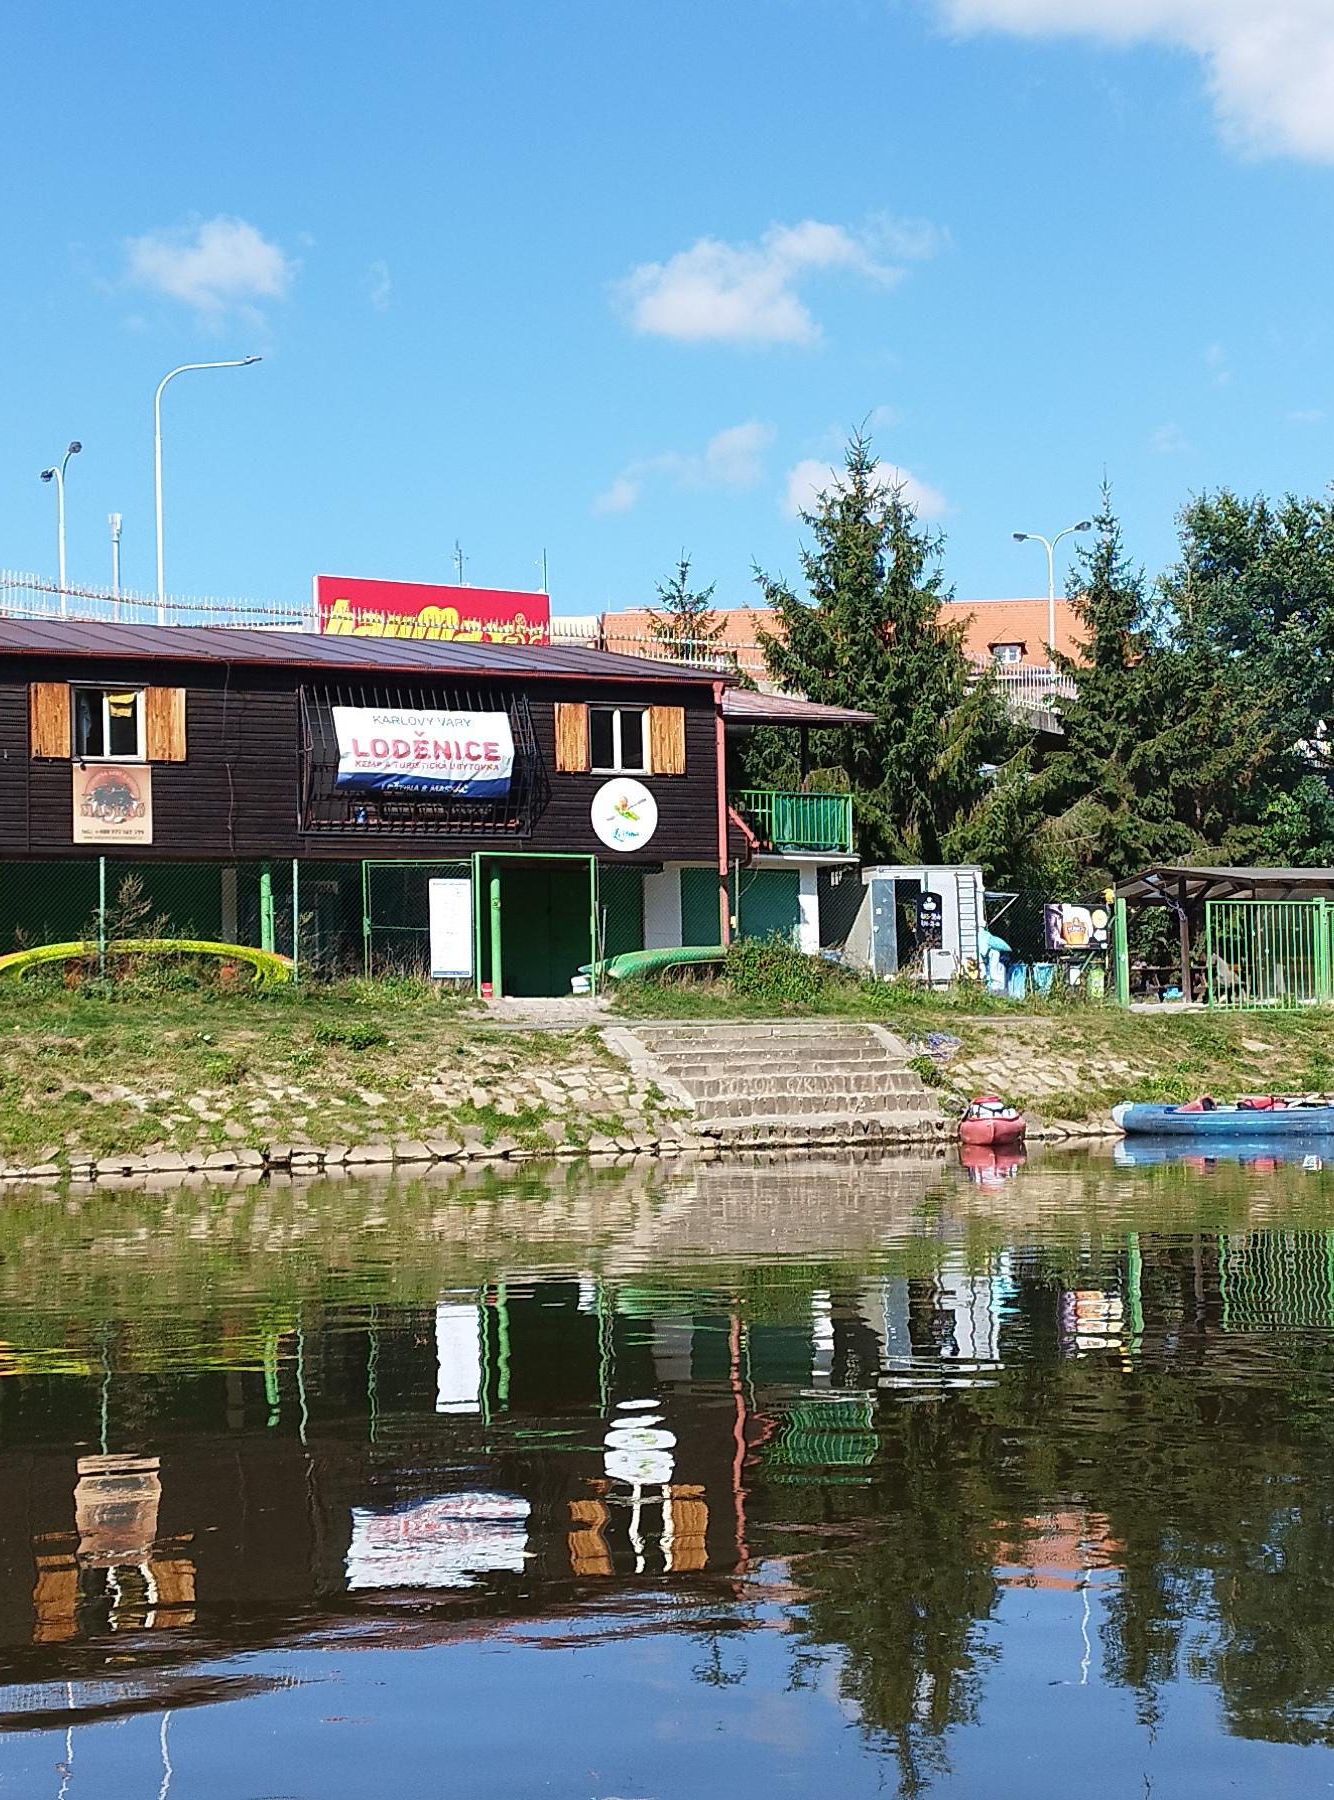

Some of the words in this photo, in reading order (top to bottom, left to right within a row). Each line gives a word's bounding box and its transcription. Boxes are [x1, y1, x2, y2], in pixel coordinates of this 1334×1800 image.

[373, 715, 433, 726] KARLOVY
[437, 717, 471, 727] VARY
[351, 731, 502, 761] LODĚNICE
